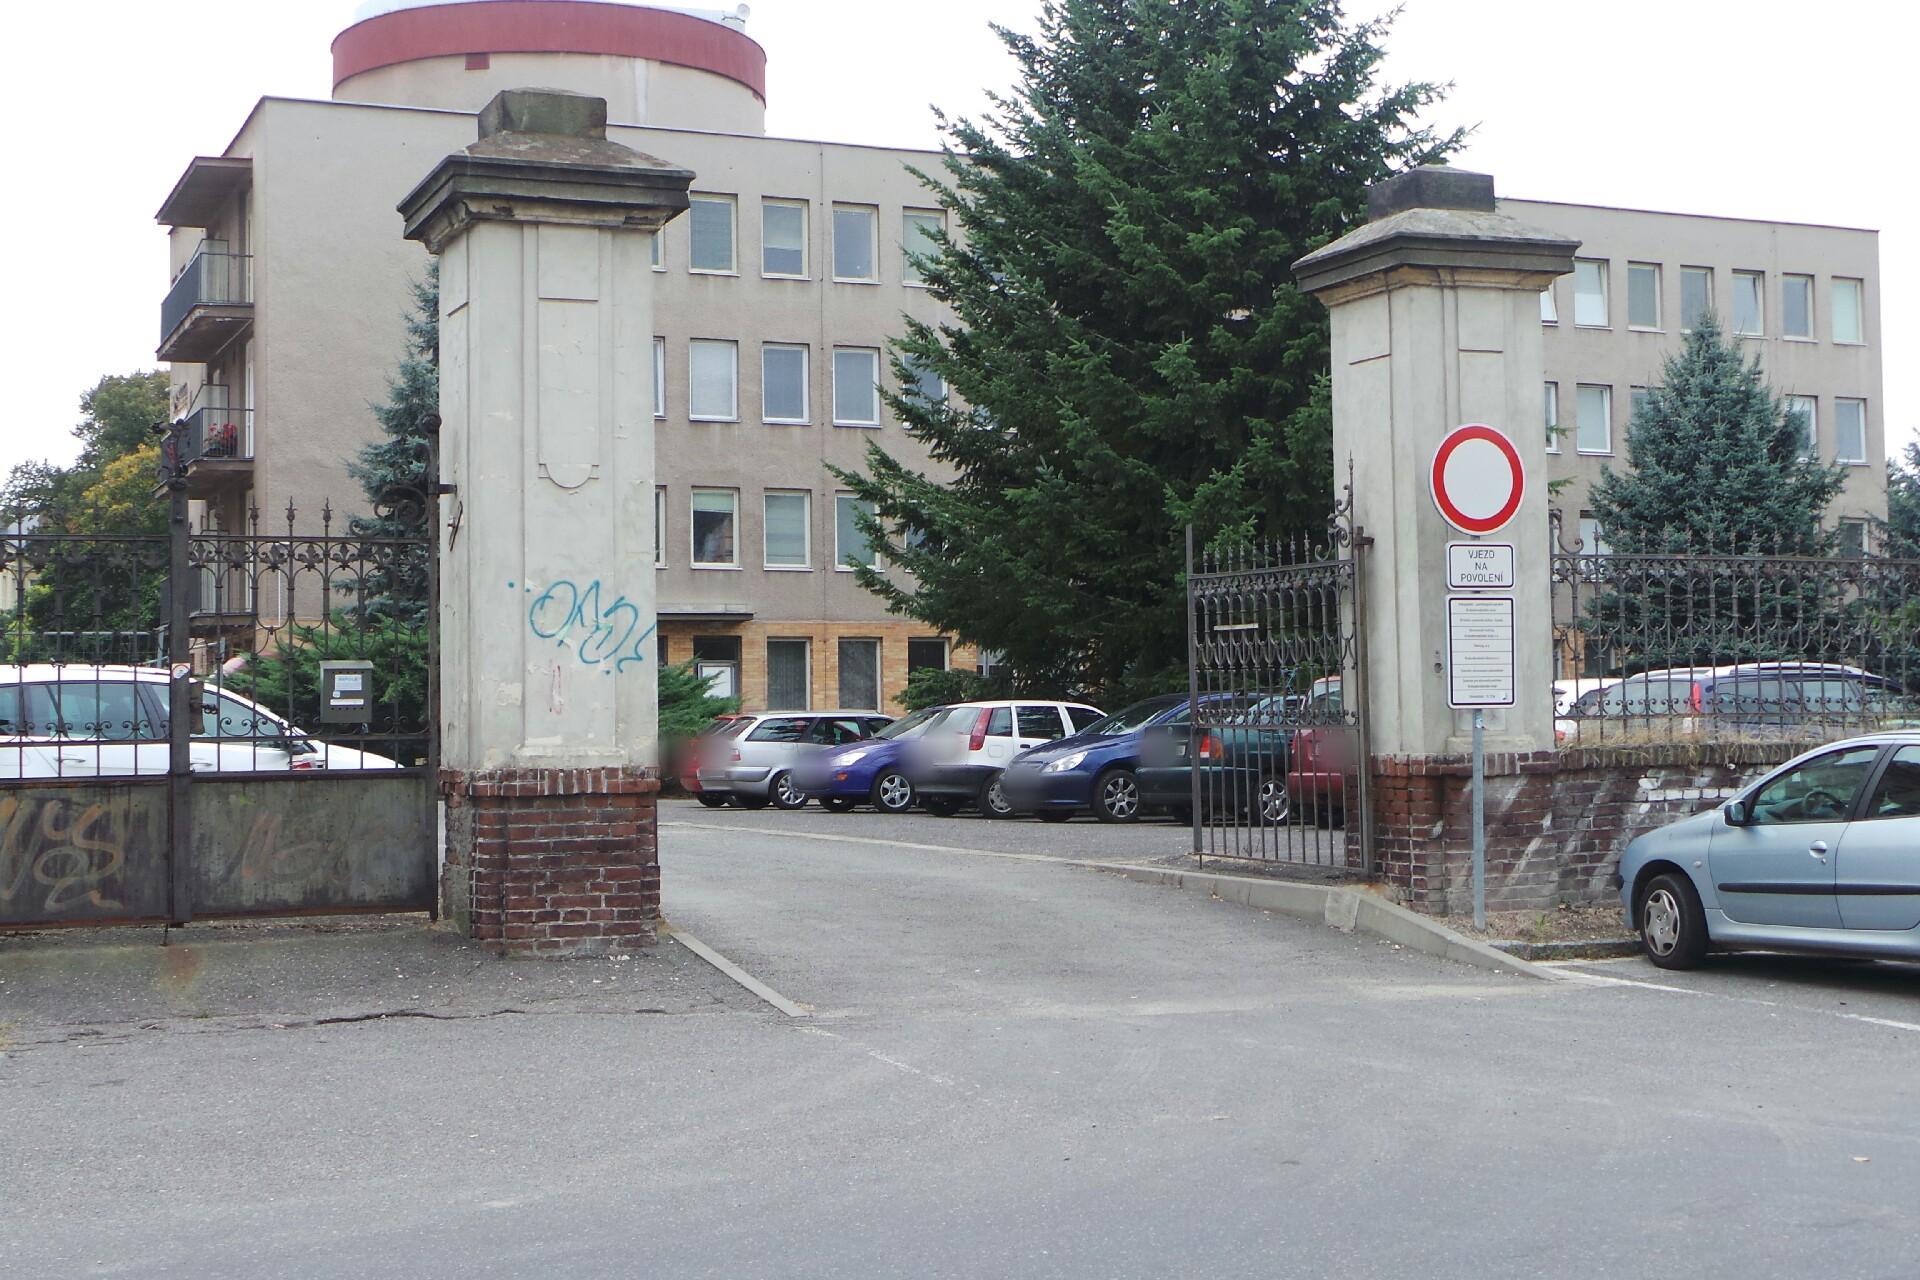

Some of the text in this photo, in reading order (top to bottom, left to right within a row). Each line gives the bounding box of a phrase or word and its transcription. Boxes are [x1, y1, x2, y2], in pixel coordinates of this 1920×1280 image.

[1468, 550, 1495, 559] VJEZD
[1475, 562, 1488, 571] NA
[1460, 571, 1503, 582] POVOLENÍ
